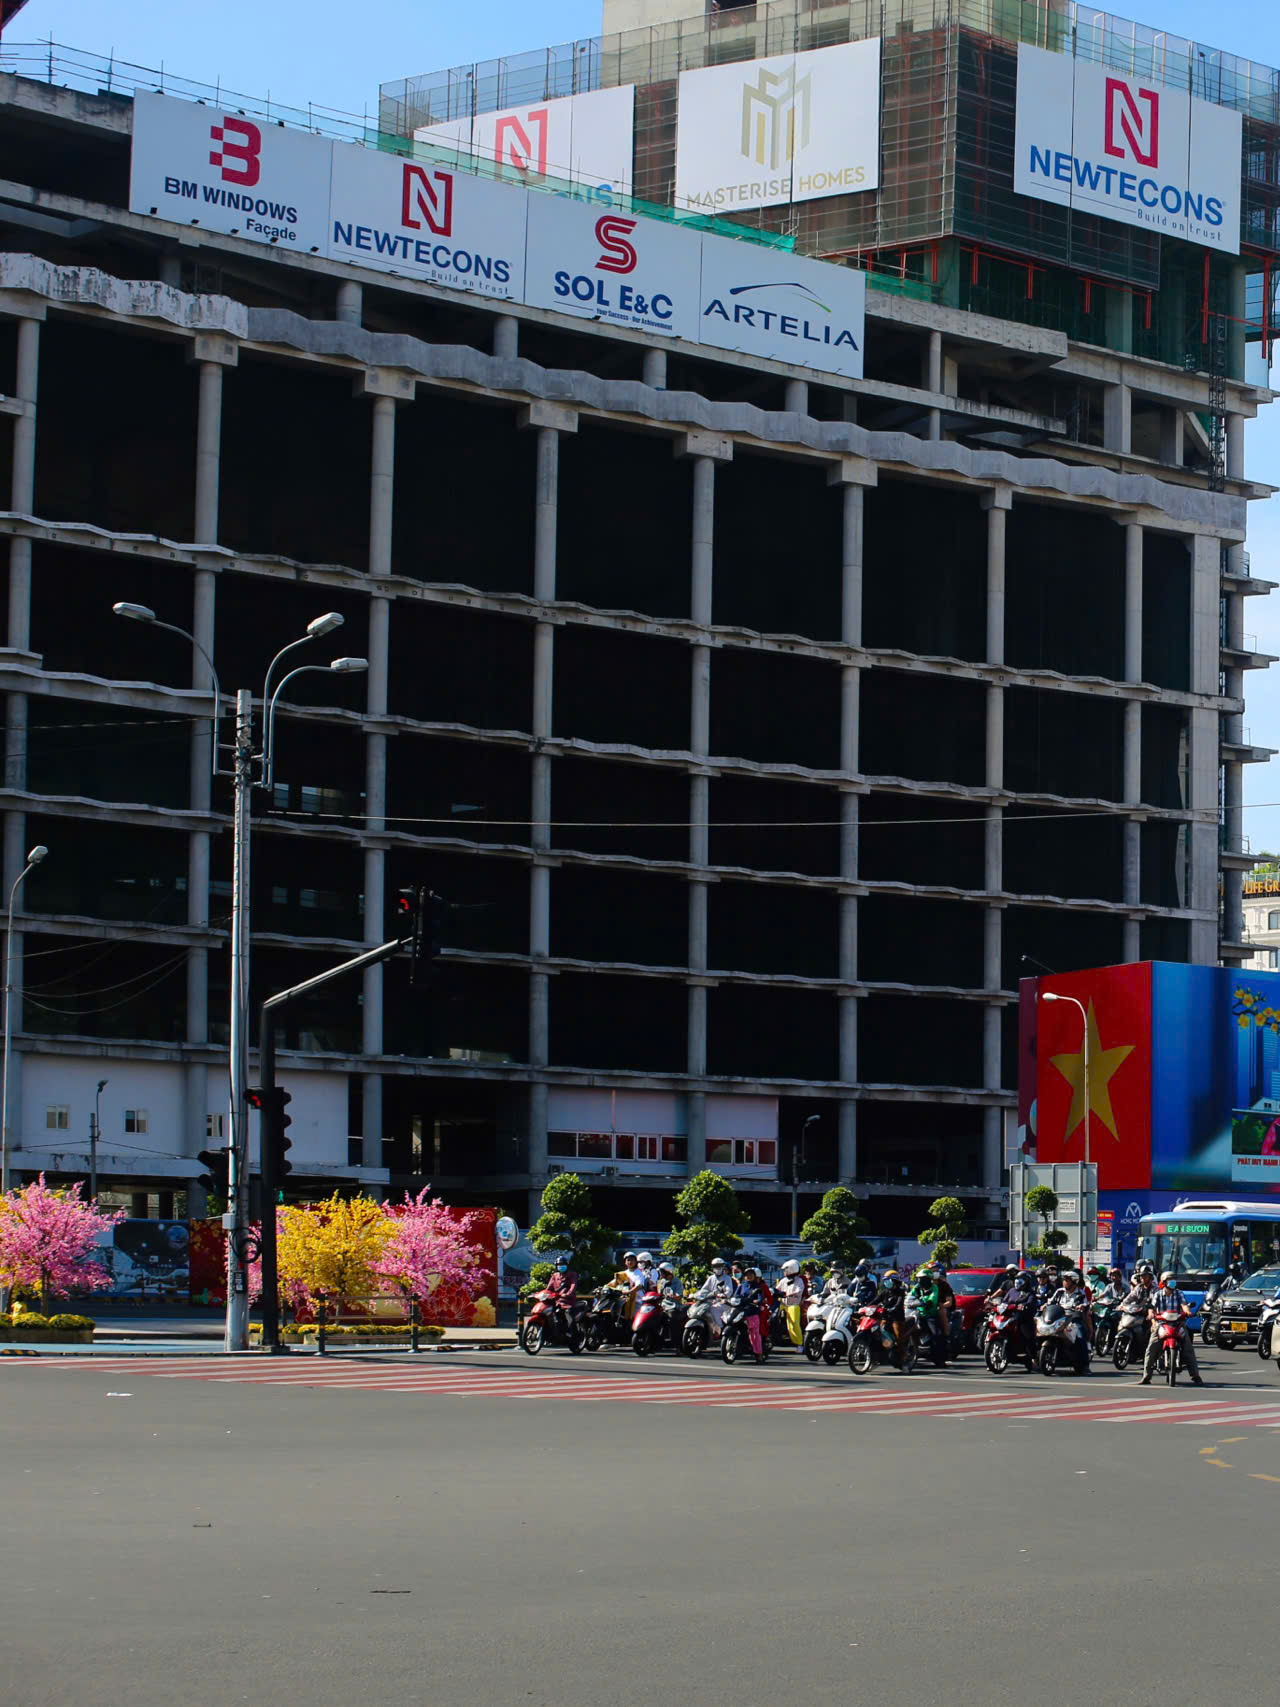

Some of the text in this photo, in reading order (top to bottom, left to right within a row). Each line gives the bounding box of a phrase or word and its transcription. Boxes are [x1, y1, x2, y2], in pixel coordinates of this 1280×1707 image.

[164, 176, 298, 224] BM WINDOWS
[687, 166, 865, 208] MASTERISE HOMES
[1029, 145, 1223, 225] NEWTECONS
[246, 219, 297, 241] Façade
[1137, 208, 1222, 241] Build on trust
[334, 221, 510, 283] NEWTECONS
[554, 271, 673, 319] SOL E&C
[703, 299, 859, 351] ARTELIA
